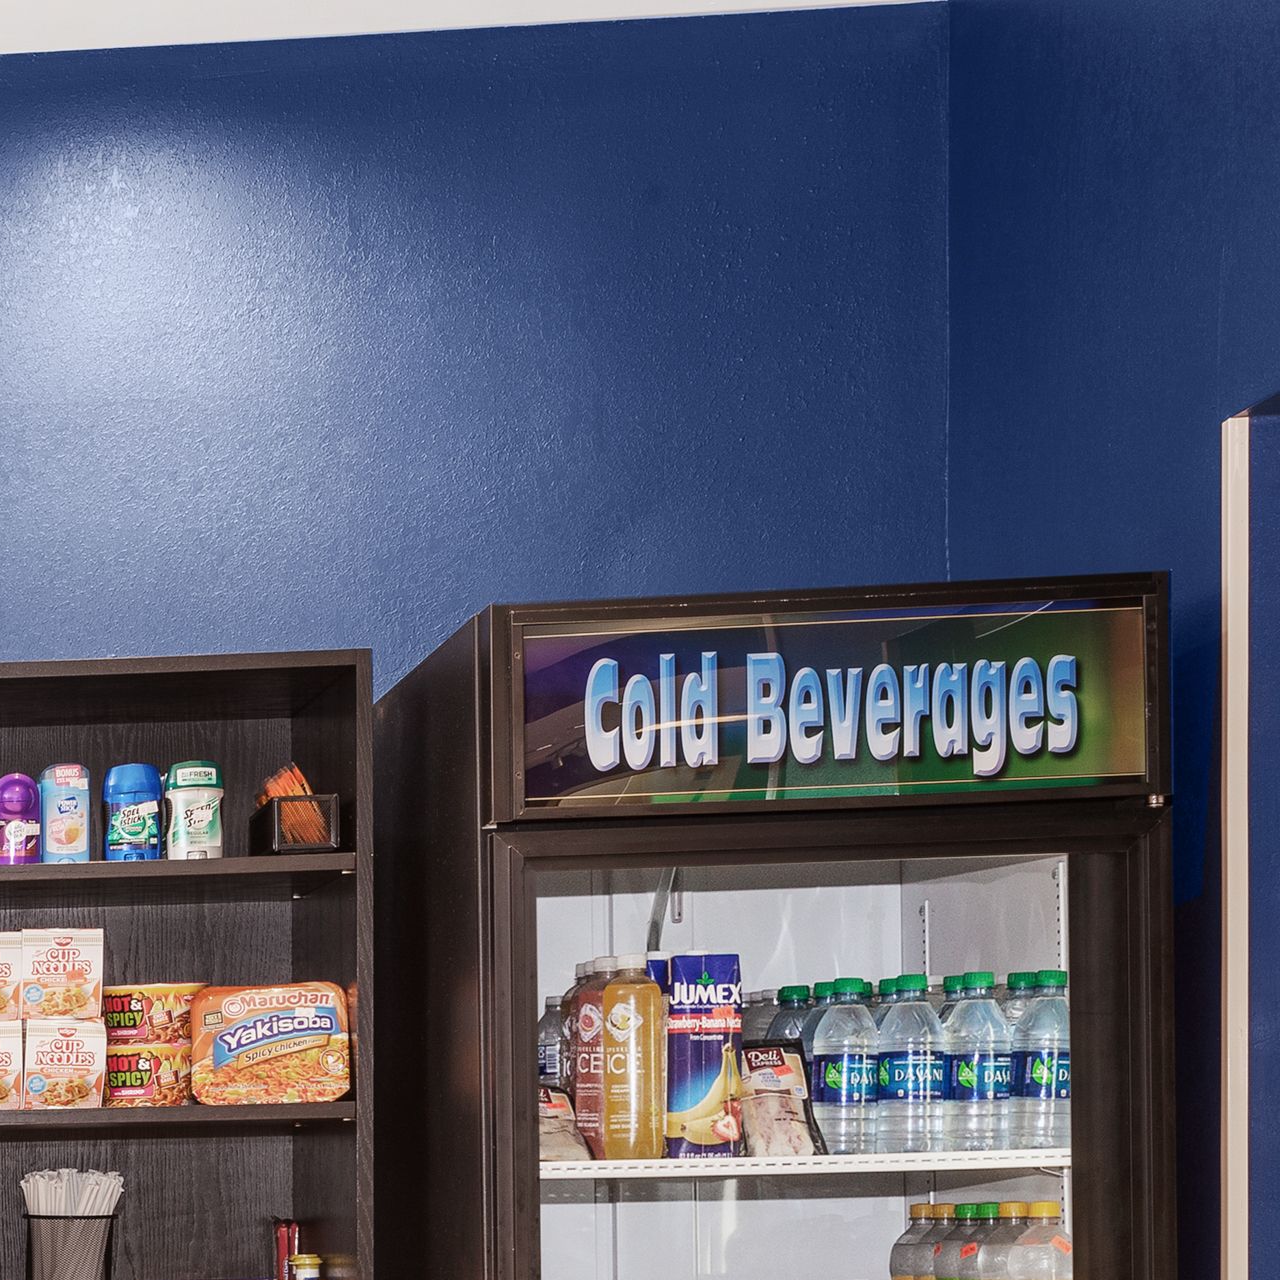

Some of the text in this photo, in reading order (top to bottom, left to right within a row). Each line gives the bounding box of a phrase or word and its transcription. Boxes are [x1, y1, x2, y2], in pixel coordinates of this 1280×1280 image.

[584, 651, 1078, 777] Cold Beverages
[56, 768, 79, 777] BONUS
[46, 949, 80, 962] CUP
[32, 961, 91, 976] NOODLES
[241, 991, 332, 1009] Maruchan
[669, 983, 742, 1005] JUMEX
[107, 1011, 142, 1028] SPICY
[220, 1015, 331, 1051] Yakisoba
[50, 1040, 84, 1053] CUP
[35, 1052, 95, 1067] NOODLES
[747, 1050, 778, 1062] Deli
[109, 1072, 150, 1086] SPICY
